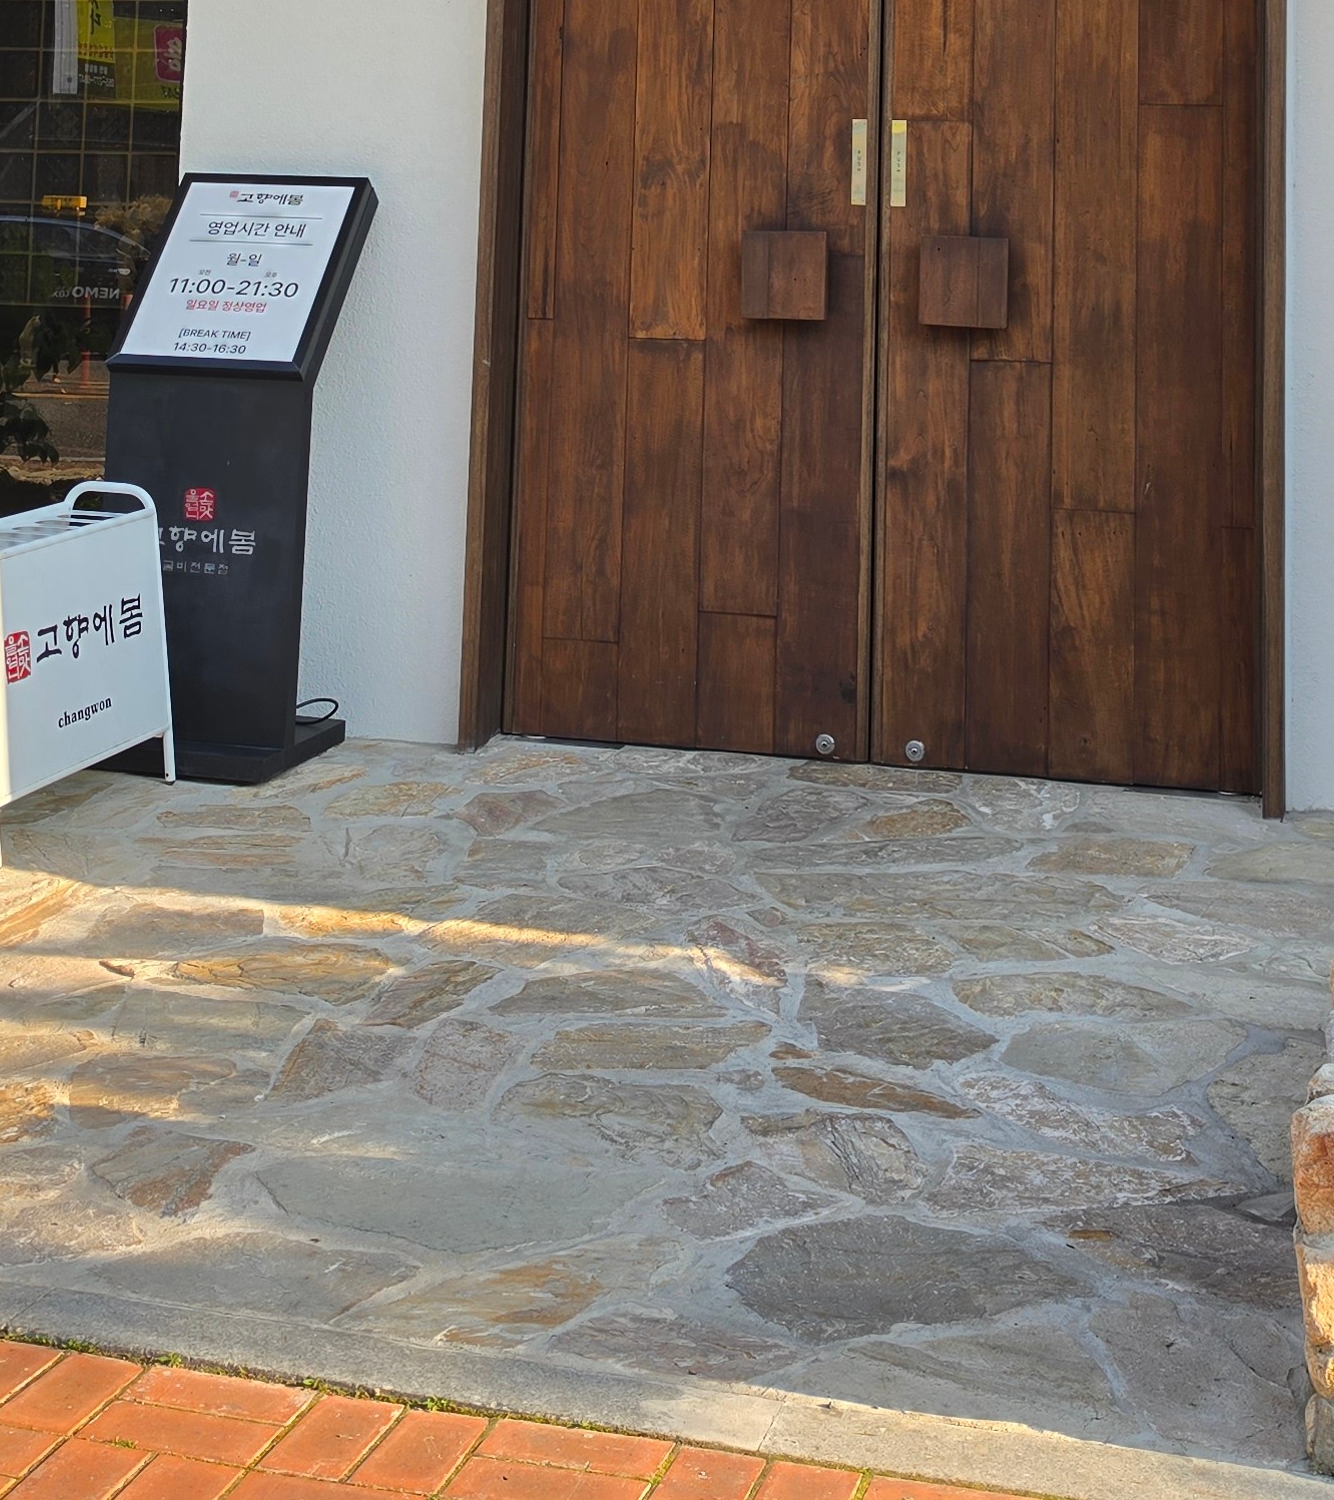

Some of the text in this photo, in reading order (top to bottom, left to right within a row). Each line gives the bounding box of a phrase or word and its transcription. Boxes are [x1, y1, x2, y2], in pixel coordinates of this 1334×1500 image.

[207, 220, 307, 238] 영업시간 안내
[226, 252, 263, 267] 월-일
[170, 277, 299, 298] 11:00-21:30
[186, 299, 267, 313] 일요일 정상영업
[178, 328, 251, 340] [BREAK TIME]
[173, 342, 247, 354] 14:30-16:30
[36, 593, 143, 663] 고향에봄
[58, 697, 113, 729] changwon
